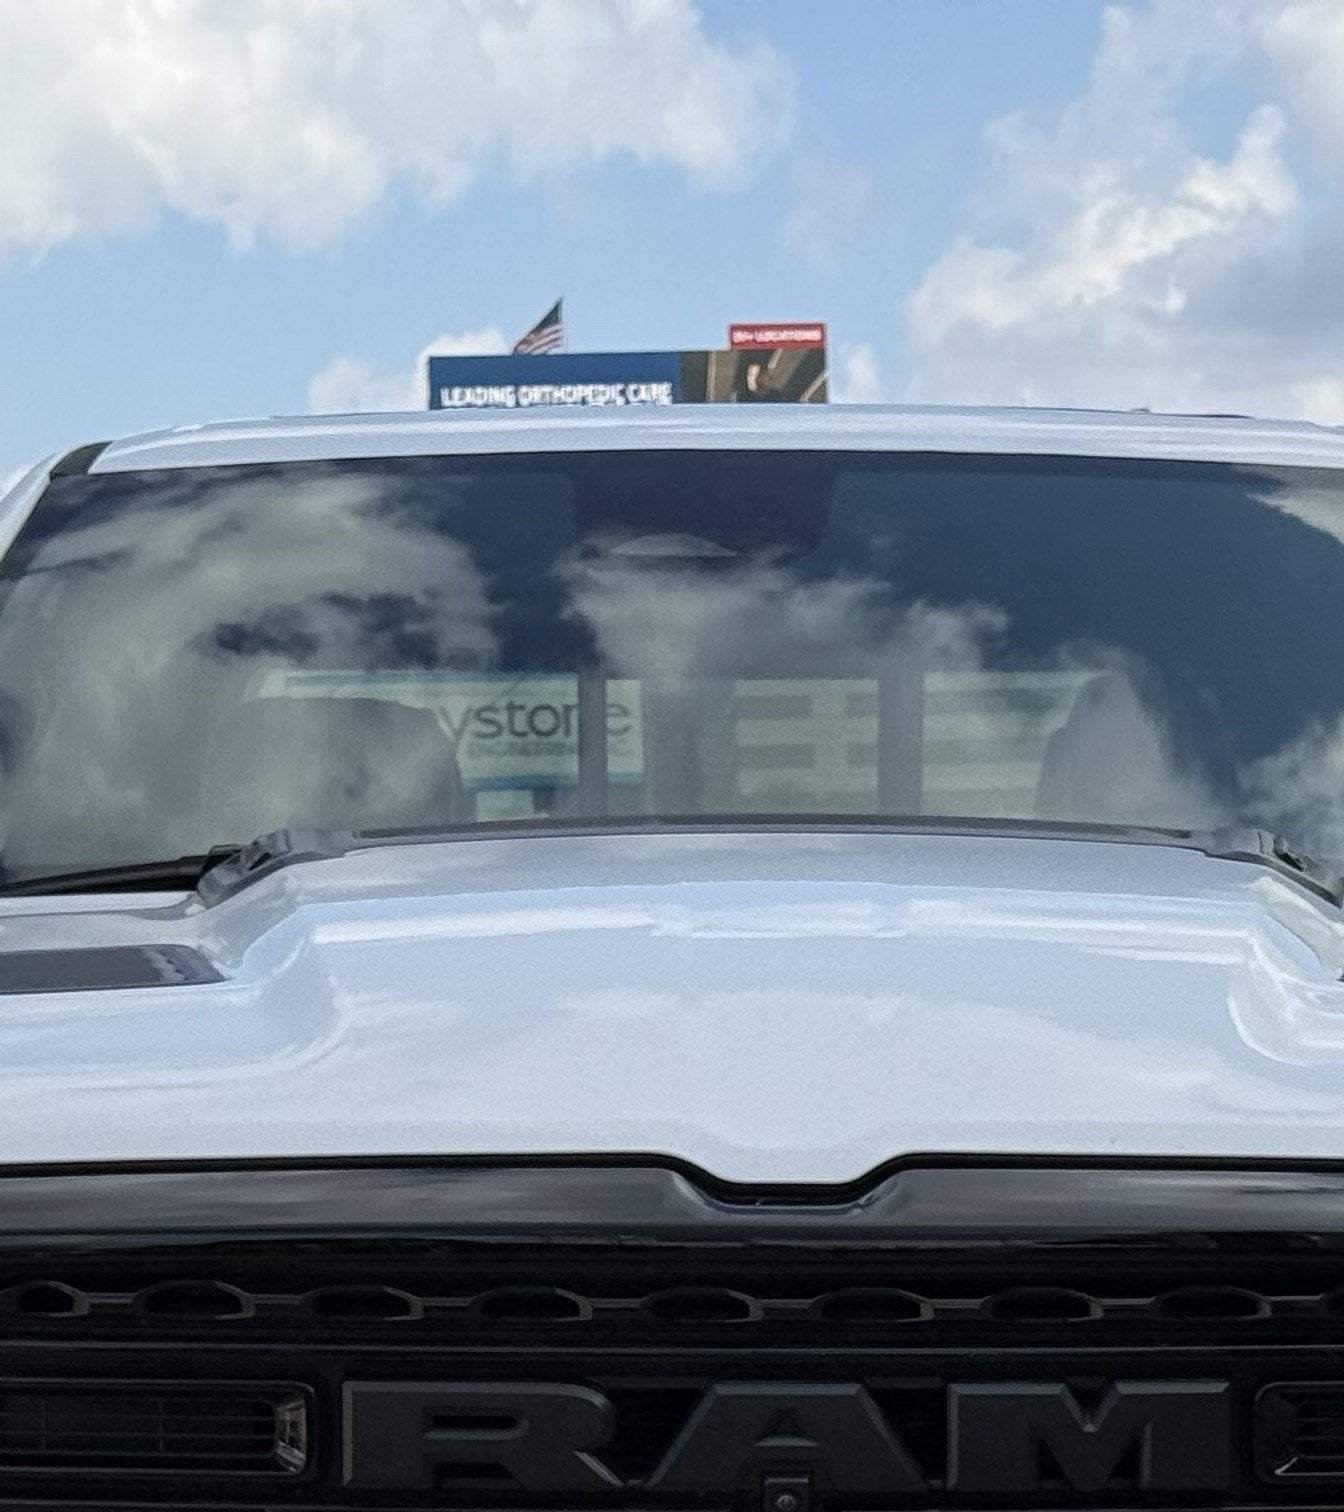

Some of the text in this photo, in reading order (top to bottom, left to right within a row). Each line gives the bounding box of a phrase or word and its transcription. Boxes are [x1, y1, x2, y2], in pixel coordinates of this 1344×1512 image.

[440, 385, 516, 408] LEADING
[627, 382, 673, 405] CARE
[341, 1380, 1232, 1490] RAM
